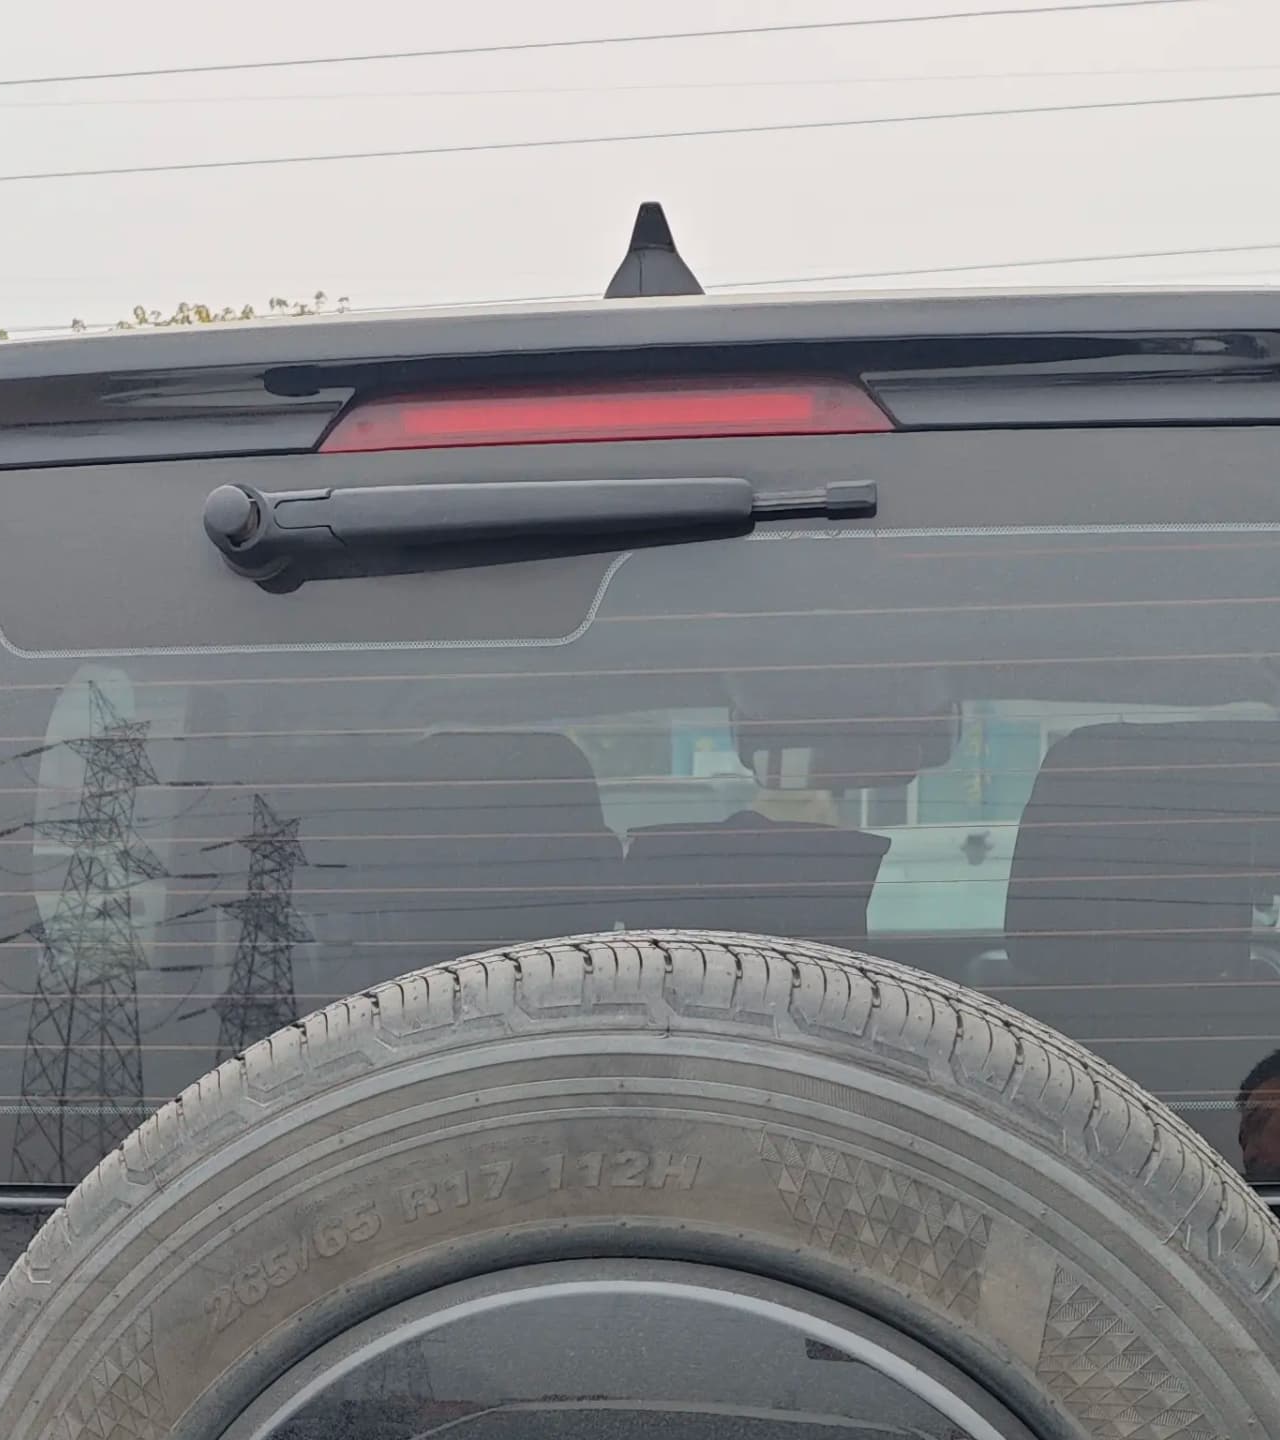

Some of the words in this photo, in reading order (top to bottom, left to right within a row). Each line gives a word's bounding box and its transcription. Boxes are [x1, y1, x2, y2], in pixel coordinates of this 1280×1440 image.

[207, 1200, 385, 1327] 265/65
[399, 1160, 515, 1224] R17
[544, 1152, 703, 1191] 112H
